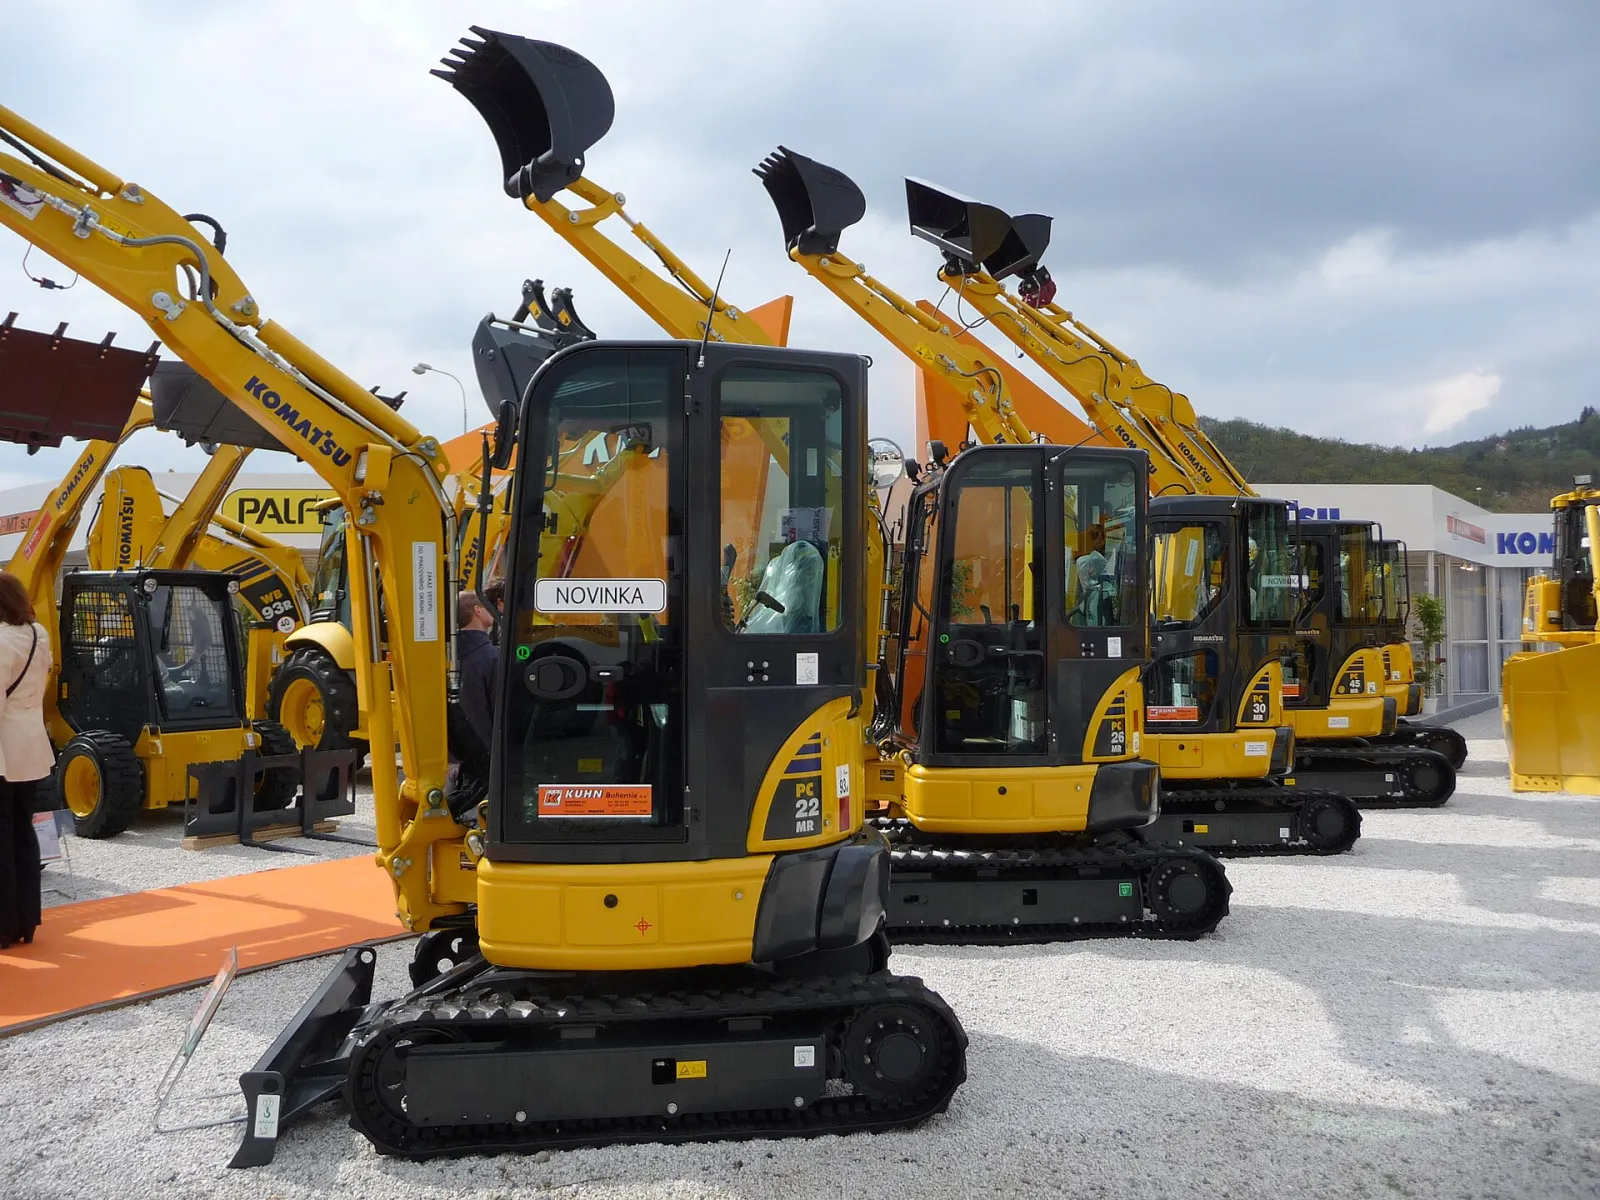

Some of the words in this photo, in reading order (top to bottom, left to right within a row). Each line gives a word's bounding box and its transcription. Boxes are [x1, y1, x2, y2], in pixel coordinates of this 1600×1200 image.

[243, 375, 352, 467] KOMATSU
[1178, 442, 1212, 483] KOMATSU
[55, 453, 95, 510] KOMATSU
[119, 496, 134, 564] KOMATSU
[260, 588, 283, 605] WB
[556, 586, 644, 604] NOVINKA
[261, 599, 294, 620] 93R
[1350, 679, 1360, 687] 45
[1253, 695, 1263, 703] PC
[1253, 703, 1266, 713] 30
[1111, 721, 1122, 731] PC
[1111, 731, 1125, 744] 26
[1111, 744, 1122, 753] MR
[565, 789, 603, 799] KUHN
[606, 791, 637, 799] Bohemia
[795, 782, 814, 798] PC
[795, 797, 820, 818] 22
[795, 819, 814, 833] MR
